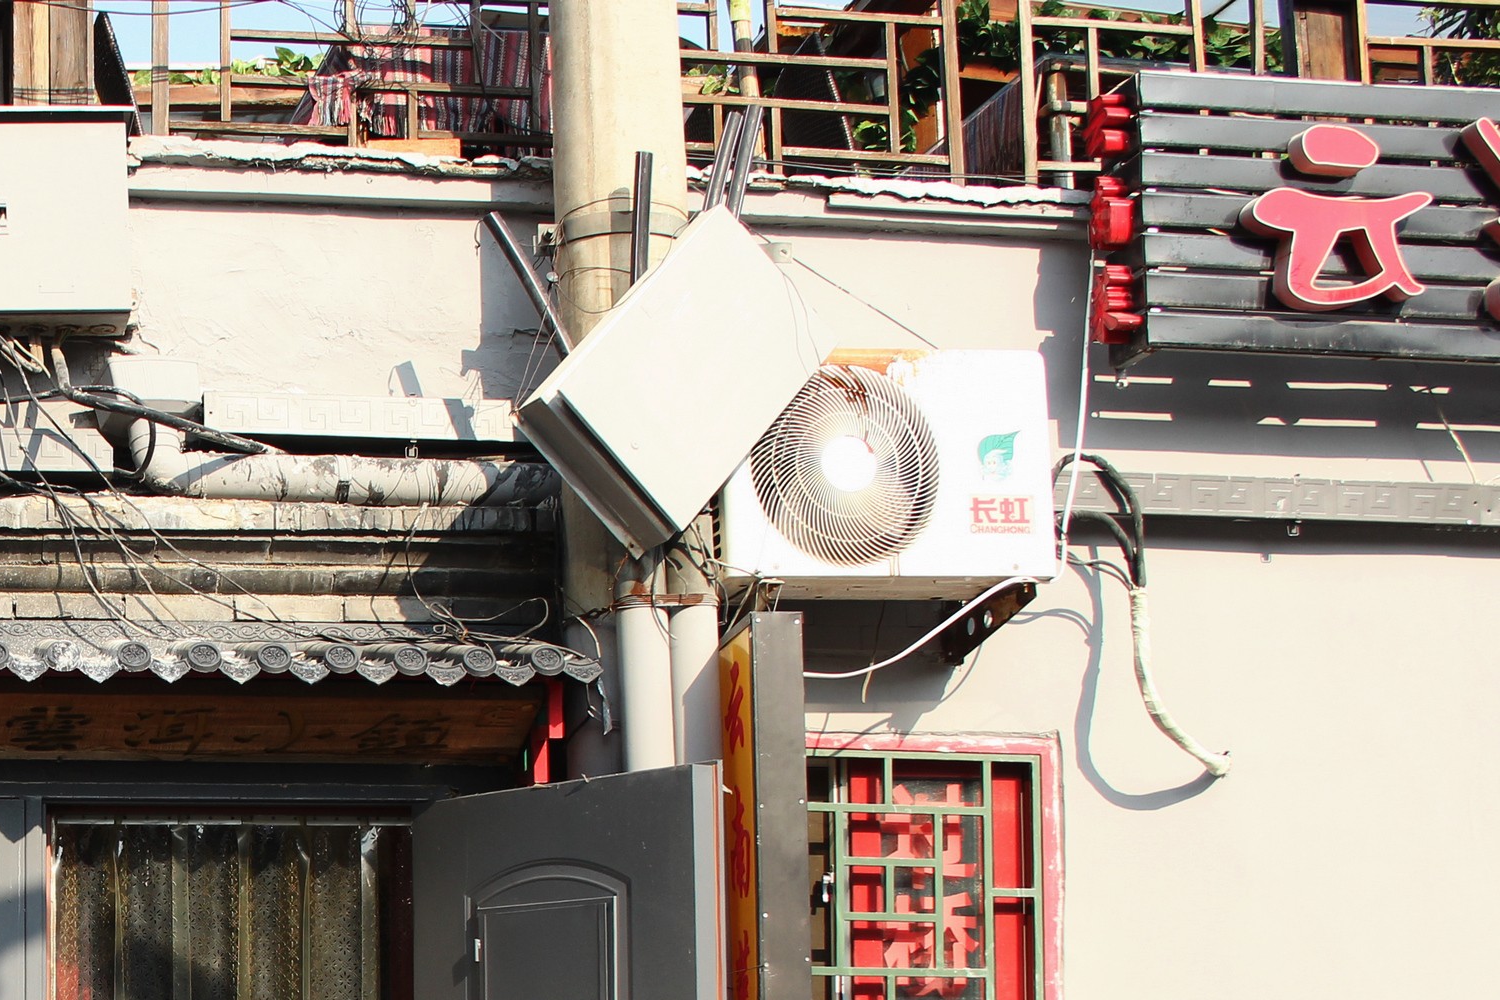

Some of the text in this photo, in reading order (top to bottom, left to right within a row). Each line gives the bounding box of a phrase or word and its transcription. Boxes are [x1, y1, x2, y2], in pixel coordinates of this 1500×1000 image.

[1242, 120, 1500, 312] 云
[970, 498, 1030, 523] 长虹
[970, 524, 1031, 534] CHANGHONG
